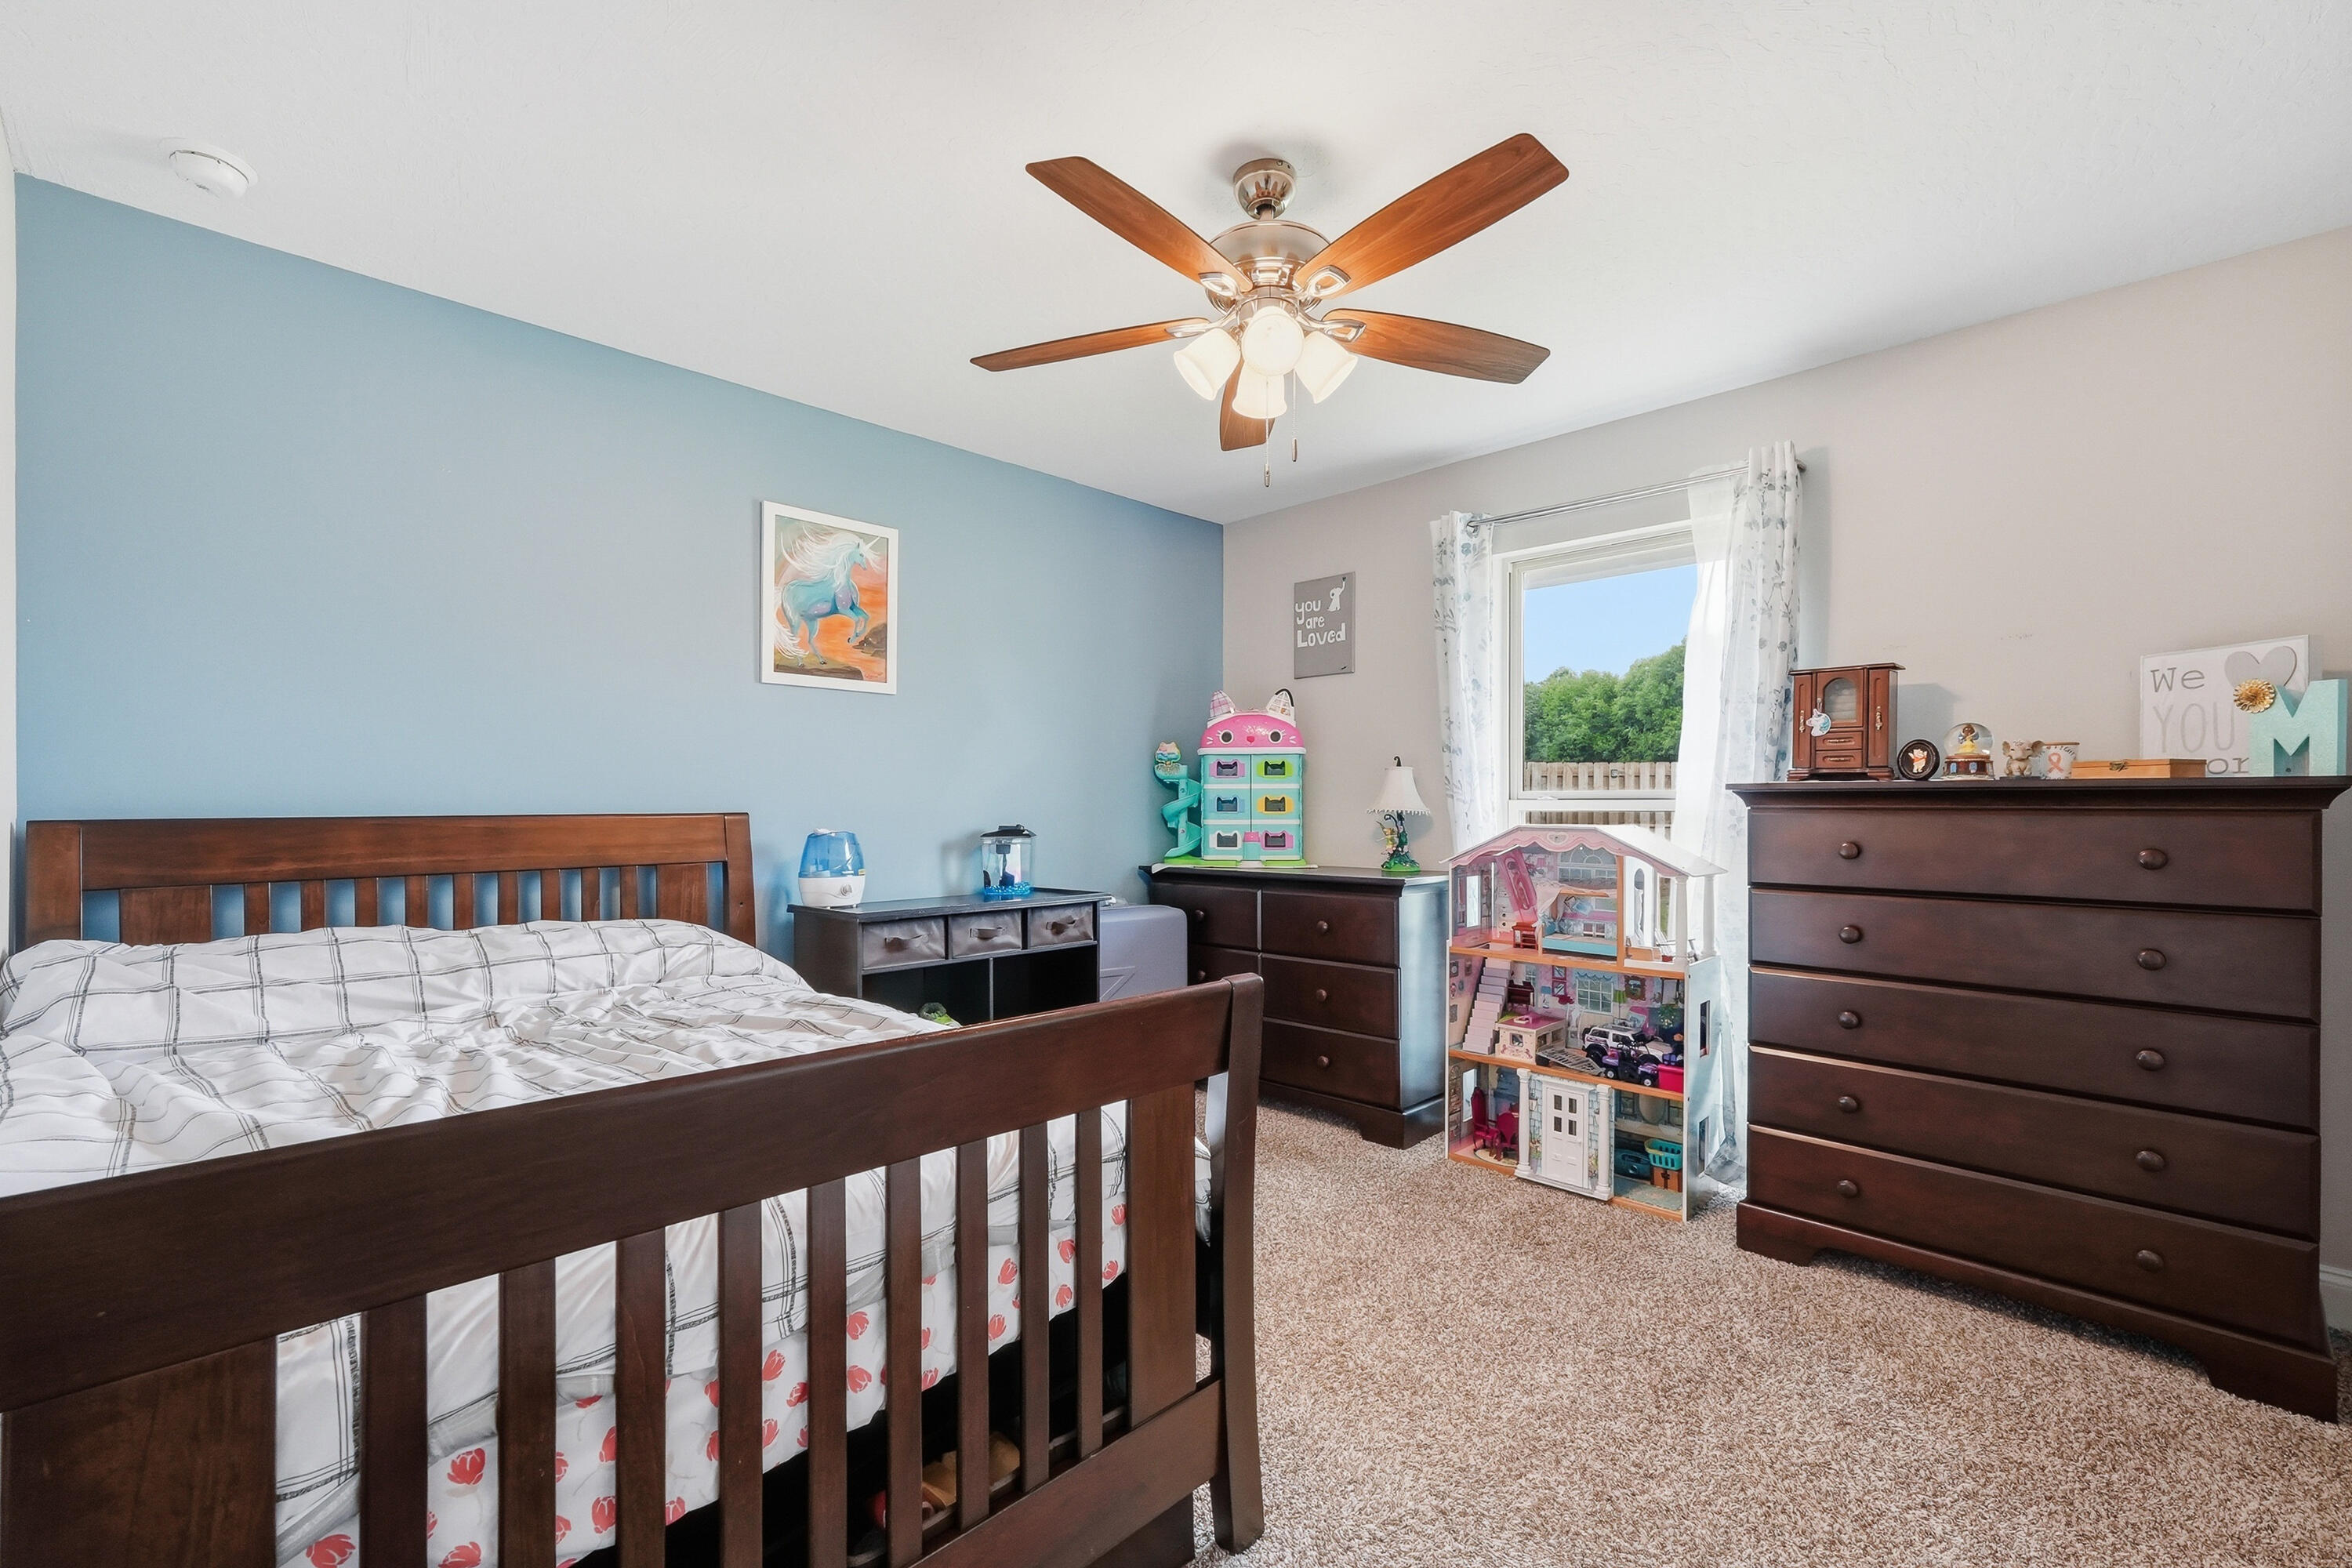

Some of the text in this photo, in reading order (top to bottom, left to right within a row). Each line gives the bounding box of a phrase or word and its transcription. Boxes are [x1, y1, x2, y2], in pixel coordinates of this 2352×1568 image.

[1294, 600, 1321, 625] you
[1305, 615, 1325, 630] are
[1297, 622, 1346, 648] Loved
[2150, 667, 2205, 693] We
[2153, 702, 2234, 753] YOU
[2247, 677, 2347, 776] M
[2206, 757, 2250, 775] or
